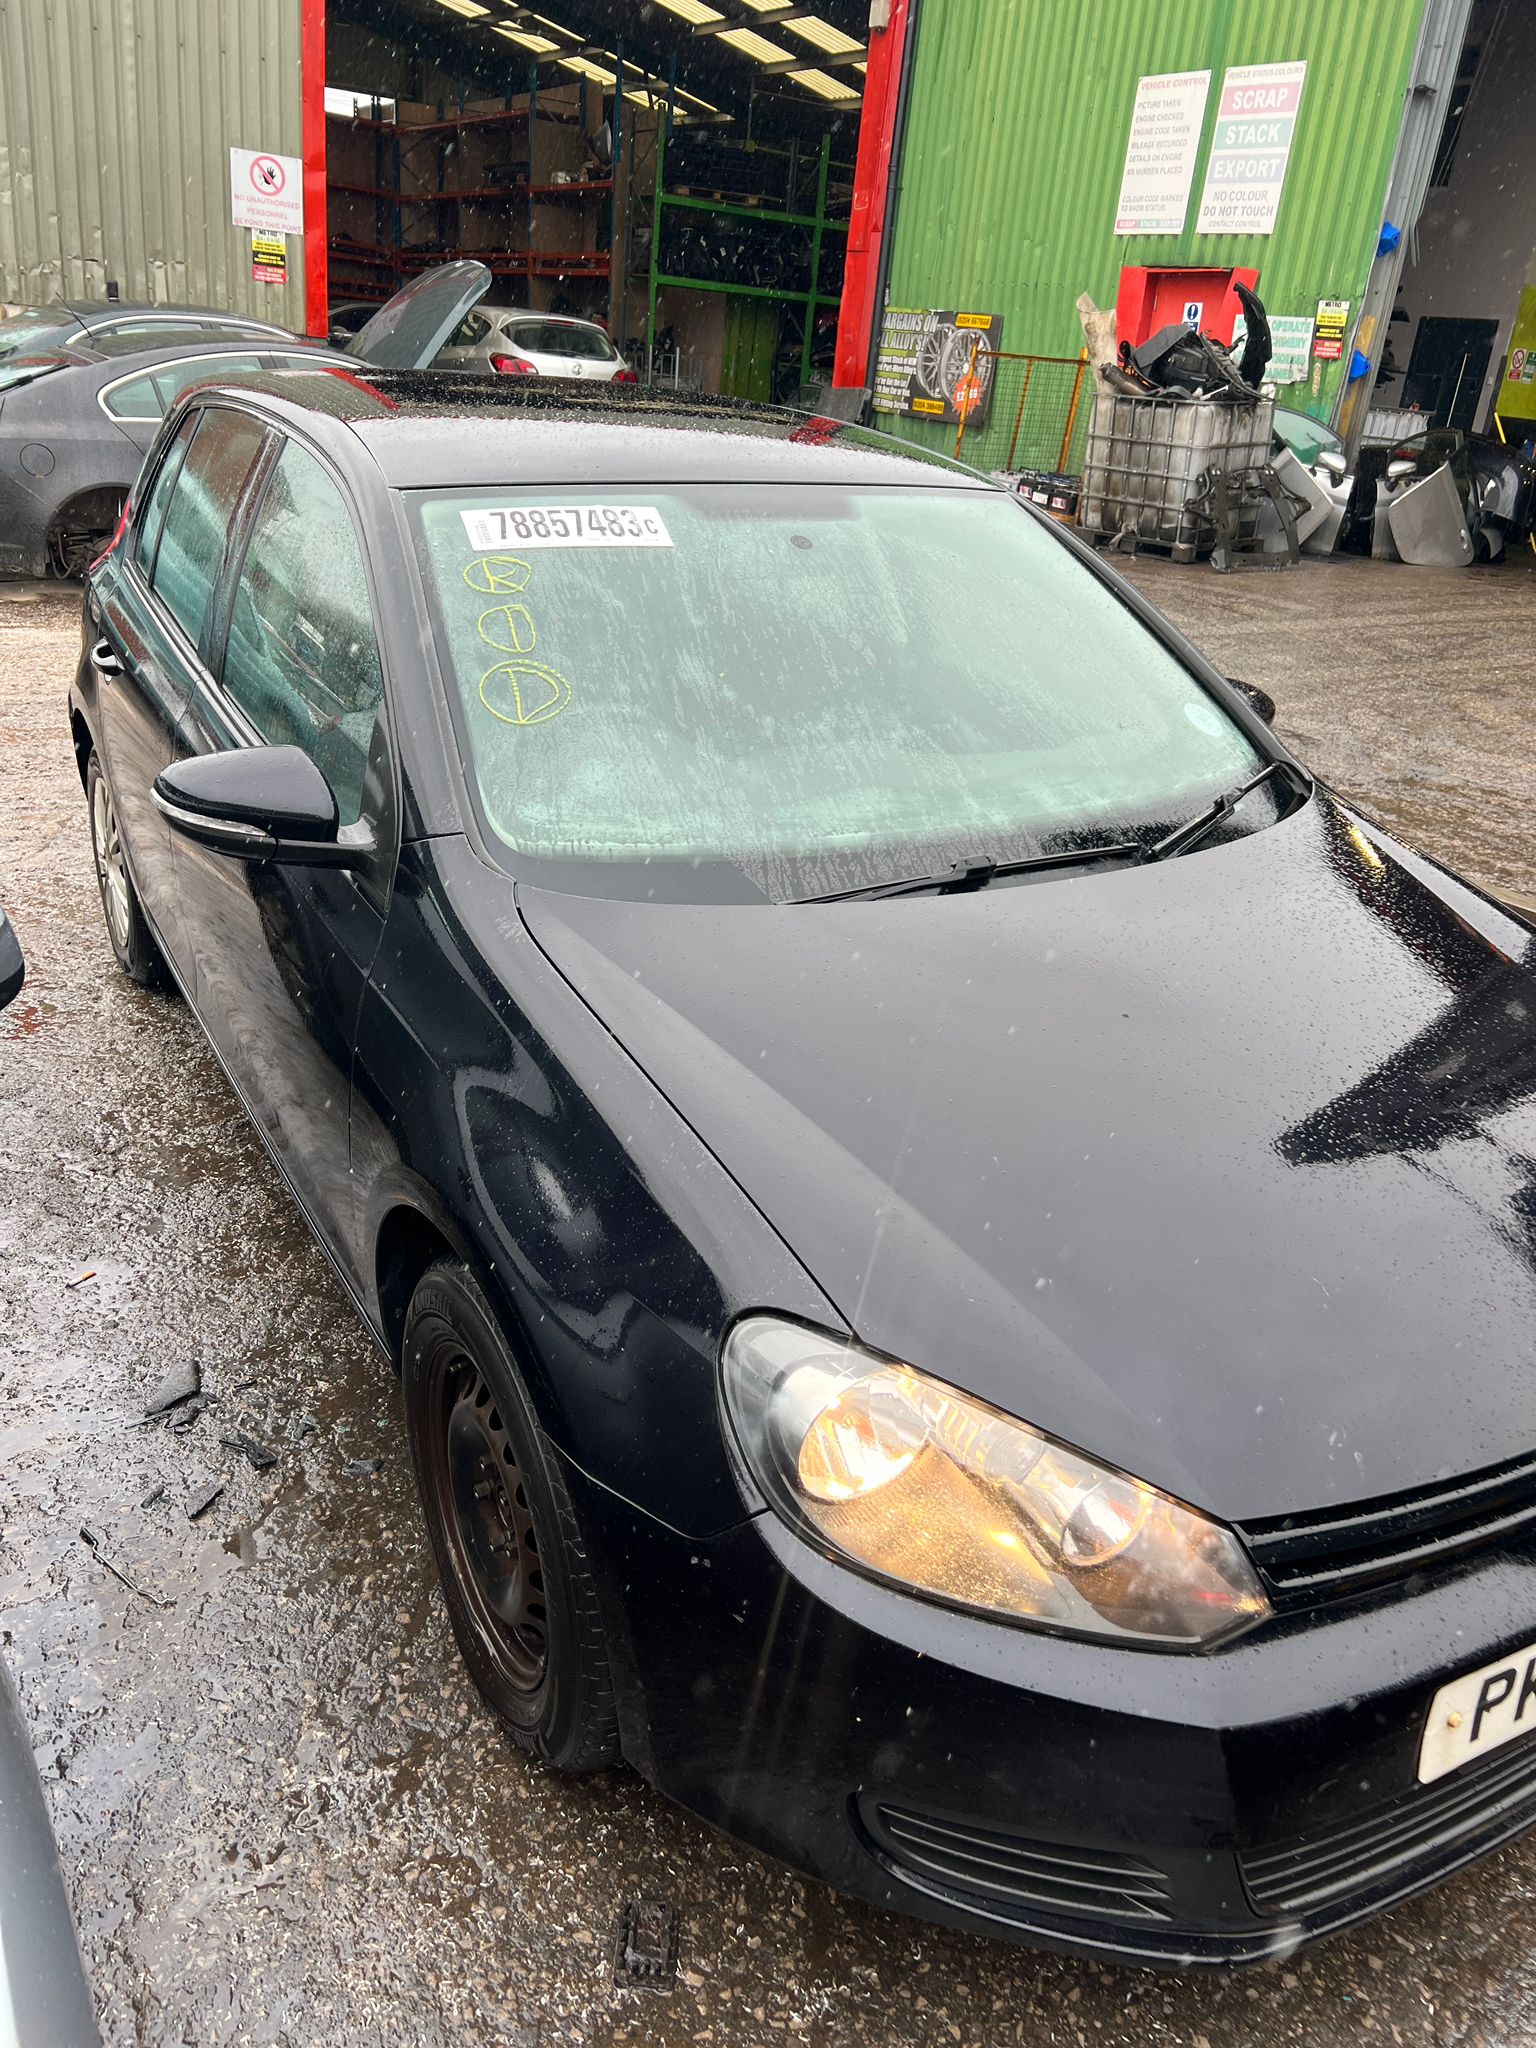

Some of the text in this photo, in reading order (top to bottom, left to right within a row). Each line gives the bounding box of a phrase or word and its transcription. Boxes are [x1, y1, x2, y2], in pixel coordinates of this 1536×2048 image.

[1228, 71, 1252, 80] VEHICLE
[1253, 68, 1274, 76] STATUS
[1141, 77, 1208, 90] VEHICLE CONTROL
[1137, 98, 1182, 109] PICTURE TAKEN
[1232, 87, 1288, 110] SCRAP
[1135, 112, 1185, 123] ENGINE CHECKED
[1133, 125, 1191, 137] ENGINE CODE TAKEN
[1225, 123, 1282, 145] STACK
[1131, 139, 1188, 149] MILEAGE RECORDED
[1128, 153, 1183, 163] DETAILS ON ENGINE
[1135, 167, 1159, 175] NUMBER
[1160, 166, 1183, 175] PLACED
[1213, 158, 1281, 179] EXPORT
[234, 193, 300, 209] NO UNAUTHORISED
[1144, 194, 1160, 203] CODE
[1160, 193, 1184, 202] MARKED
[1212, 190, 1268, 202] NO COLOUR
[247, 208, 288, 220] PERSONNEL
[1120, 204, 1128, 212] TO
[1128, 204, 1145, 212] SHOW
[1202, 206, 1274, 217] DO NOT TOUCH
[234, 217, 301, 232] BEYOND THIS POINT
[1140, 220, 1157, 228] STACK
[1234, 220, 1262, 228] CONTROL
[923, 314, 939, 332] ON
[1271, 320, 1310, 333] OPERATE
[880, 332, 889, 348] LL
